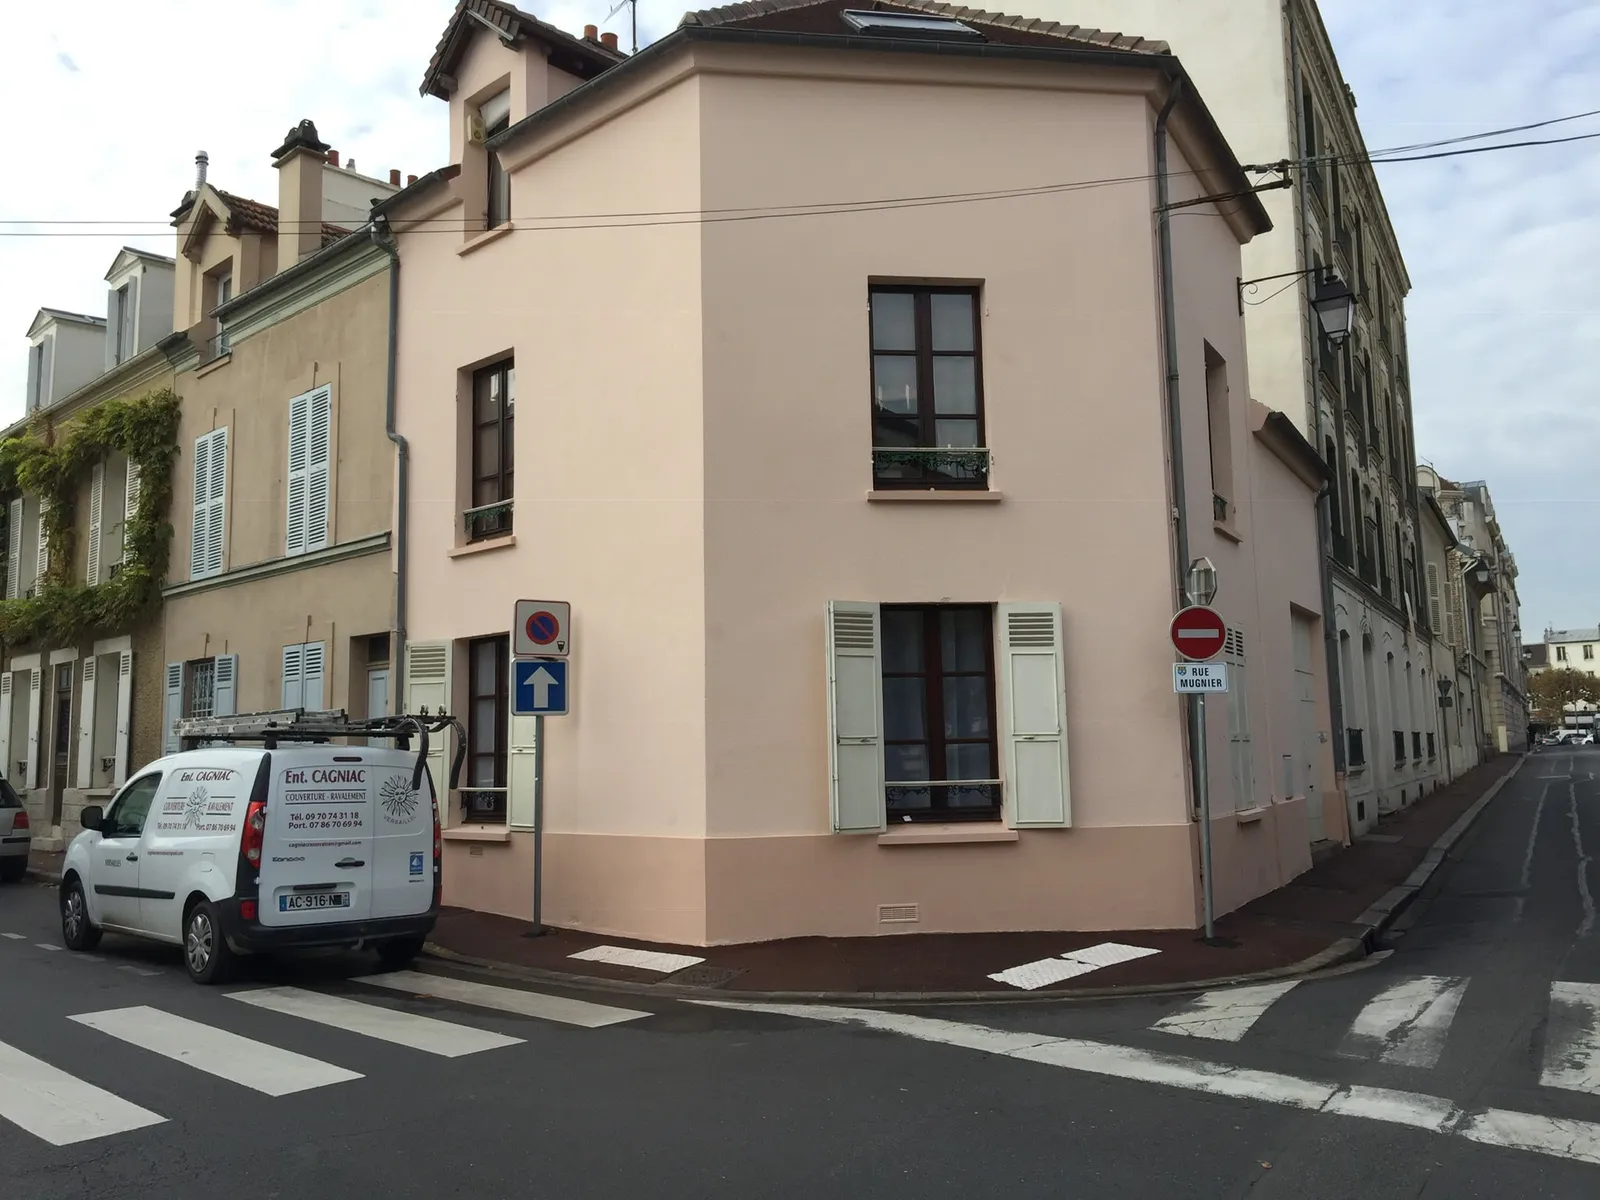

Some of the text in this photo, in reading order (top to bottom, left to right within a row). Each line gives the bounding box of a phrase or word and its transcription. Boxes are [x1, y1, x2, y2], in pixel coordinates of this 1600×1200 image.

[1192, 668, 1209, 676] RUE
[1180, 679, 1222, 688] MUGNIER
[196, 770, 234, 781] CAGNIAC
[285, 769, 366, 784] Ent. CAGNIAC
[285, 792, 326, 801] COUVERTURE
[330, 792, 366, 800] RAVALEMENT
[290, 813, 304, 821] Tél.
[305, 813, 316, 821] 09
[328, 812, 338, 820] 74
[340, 812, 348, 820] 31
[350, 812, 360, 820] 18
[288, 894, 342, 908] AC-916-N
